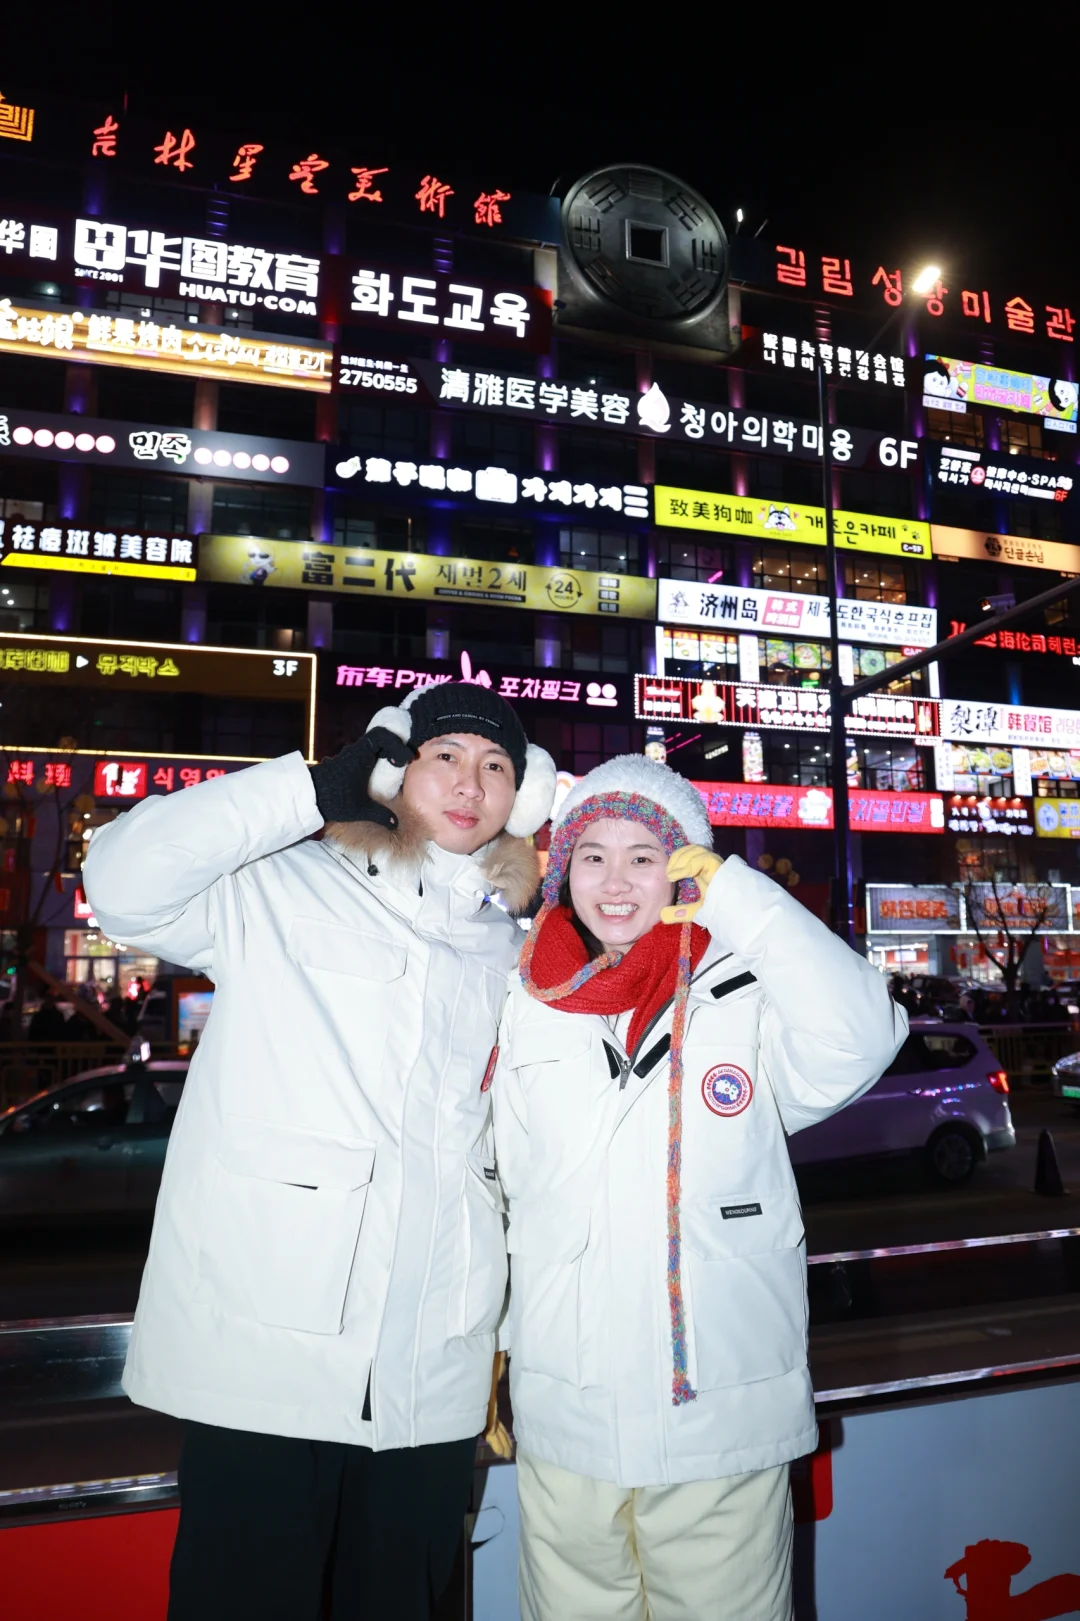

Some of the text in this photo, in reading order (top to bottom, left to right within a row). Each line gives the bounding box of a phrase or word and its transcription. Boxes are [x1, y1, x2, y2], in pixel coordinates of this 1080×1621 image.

[351, 269, 530, 338] 화도교육
[338, 368, 418, 394] 2750555
[439, 367, 631, 424] 清雅医学美容
[680, 402, 854, 461] 청아의학미용
[128, 430, 192, 464] 민족
[878, 437, 919, 469] 6F
[1054, 488, 1068, 502] 6F
[669, 498, 754, 525] 致美狗咖
[1004, 546, 1045, 564] 단골손님
[554, 580, 574, 595] 24
[699, 592, 759, 623] 济州岛
[1000, 630, 1047, 653] 海伦司
[1047, 636, 1080, 656] 헤런
[272, 659, 299, 677] 3F
[498, 676, 582, 702] 포차핑크
